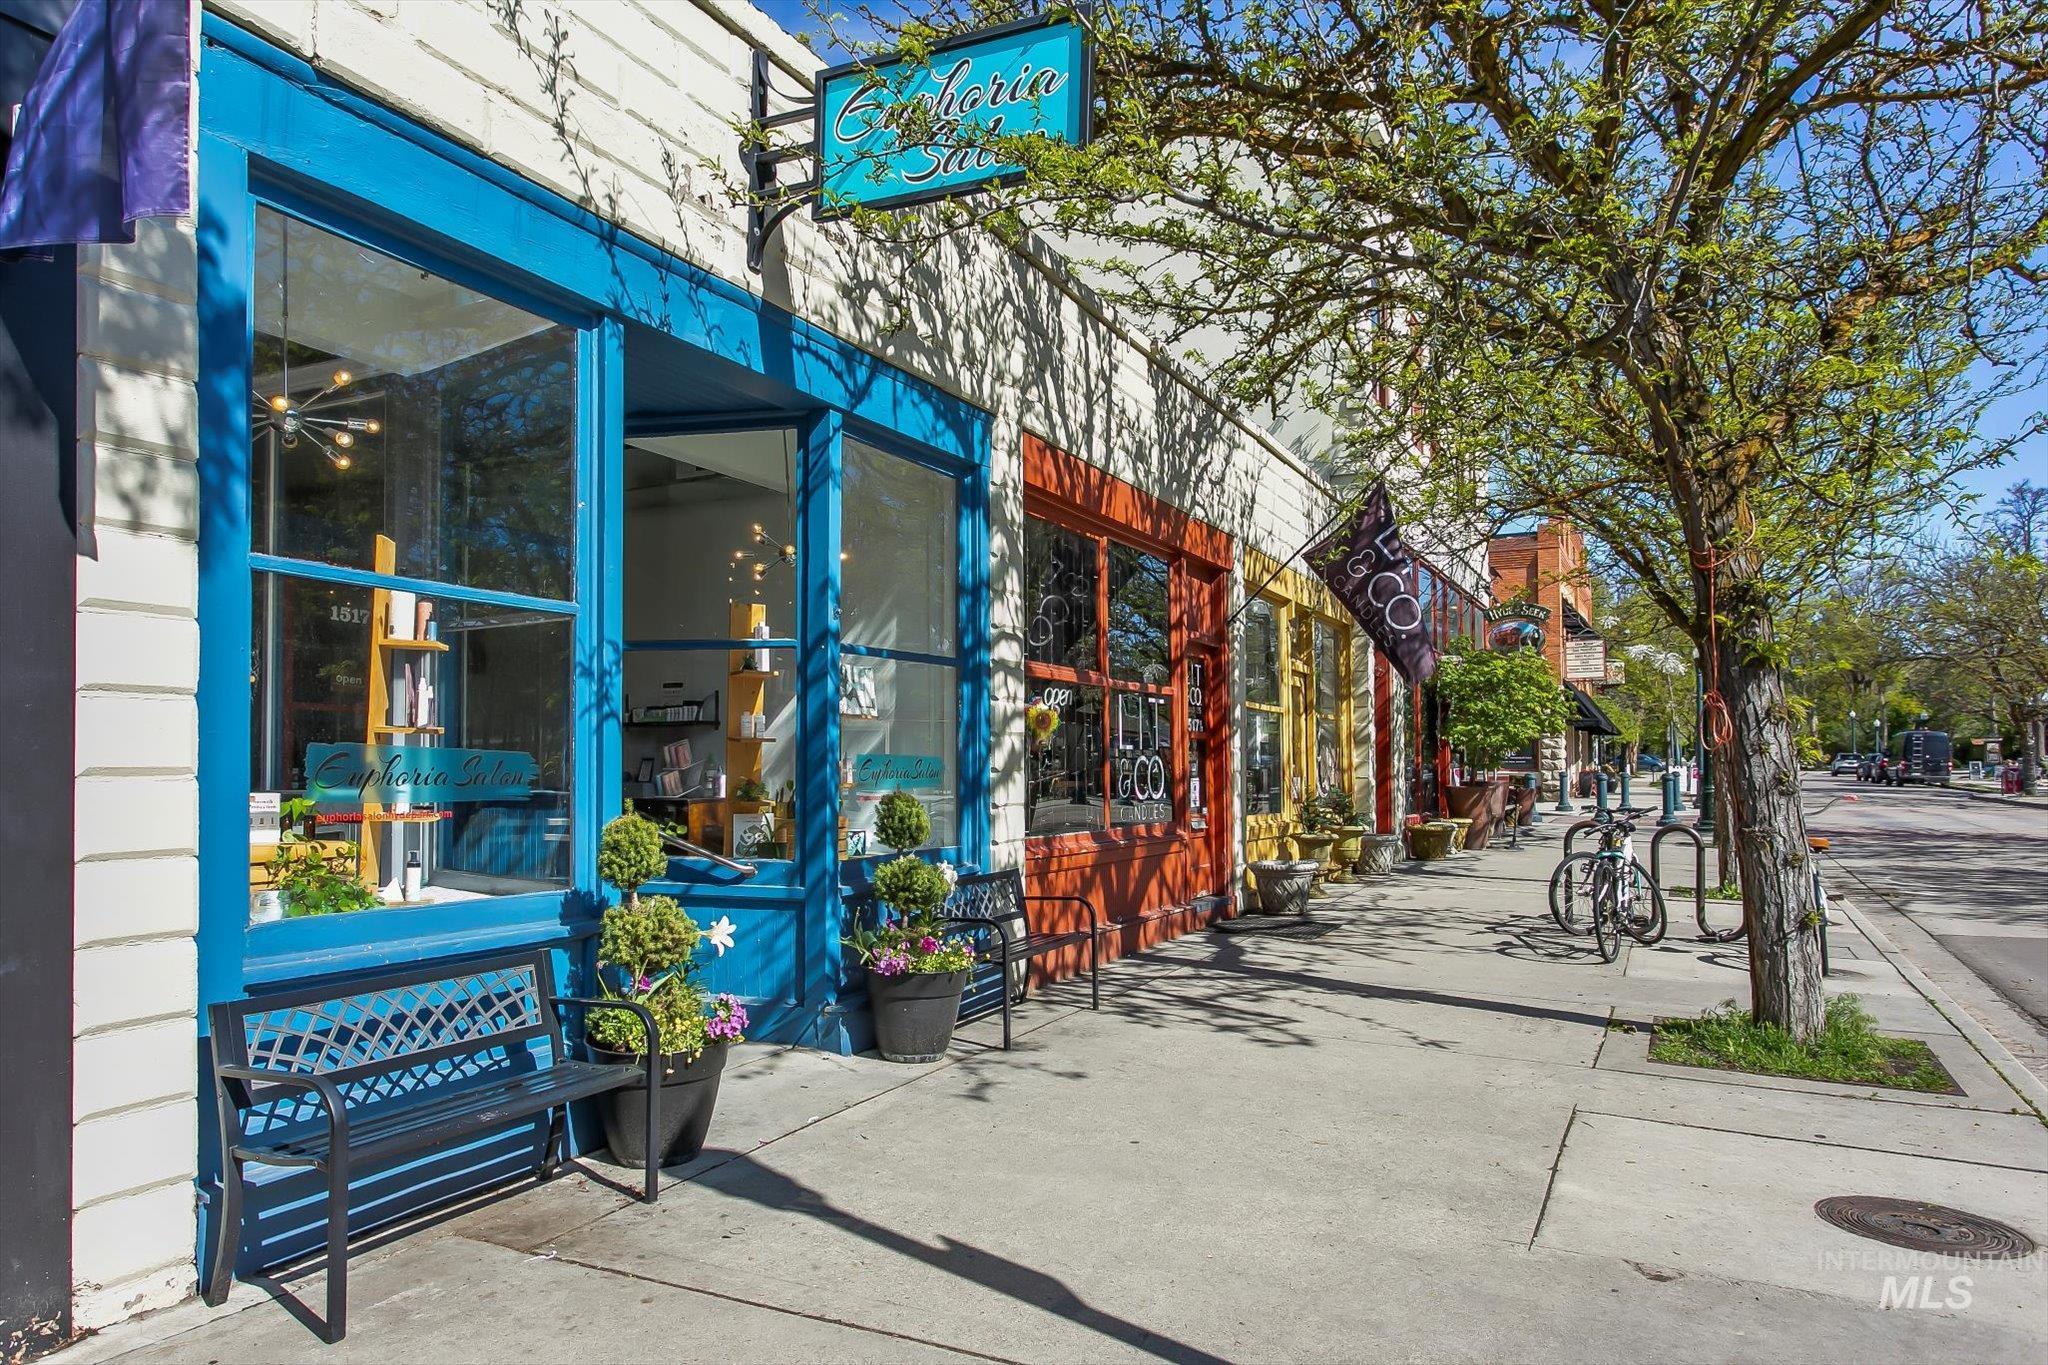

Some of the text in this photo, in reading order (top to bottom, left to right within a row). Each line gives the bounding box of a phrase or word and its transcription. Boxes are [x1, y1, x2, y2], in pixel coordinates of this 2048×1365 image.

[330, 605, 369, 624] 1517
[1333, 575, 1396, 648] CANDLES
[1521, 605, 1547, 620] SEEK
[1187, 664, 1202, 687] IT
[1119, 694, 1166, 751] LIT
[315, 752, 525, 799] Euphoria Salon
[859, 758, 940, 786] Euphoria Salon
